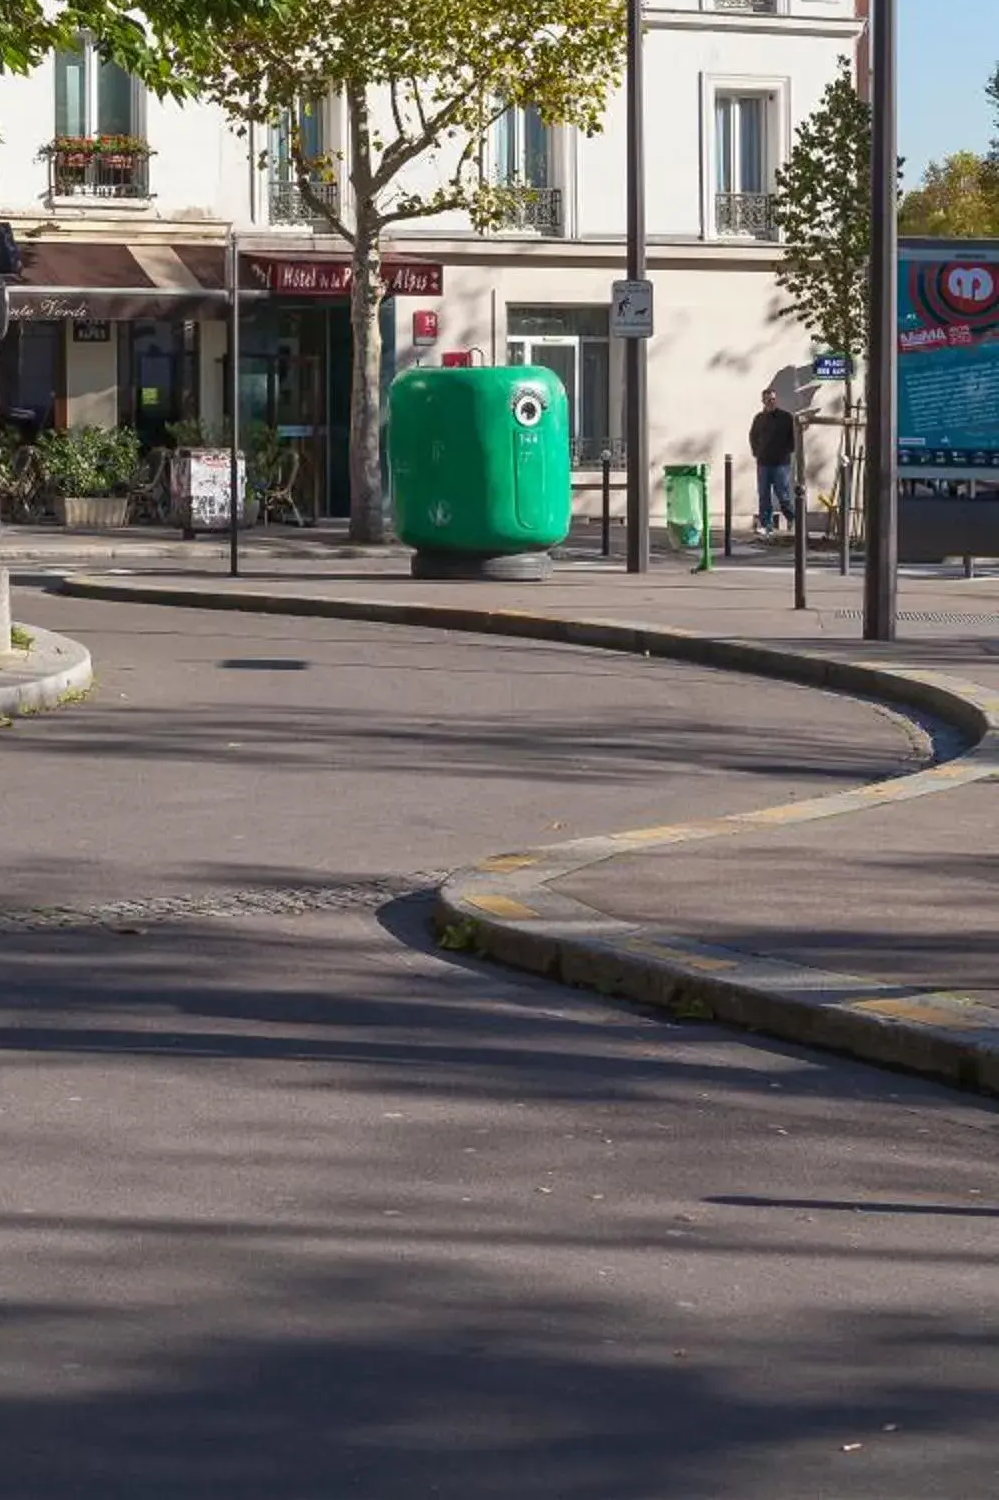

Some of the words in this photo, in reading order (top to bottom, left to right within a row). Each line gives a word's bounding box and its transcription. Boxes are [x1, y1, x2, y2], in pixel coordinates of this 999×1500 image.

[282, 267, 317, 289] Hôtel
[40, 298, 88, 318] Verdi
[424, 315, 437, 328] H
